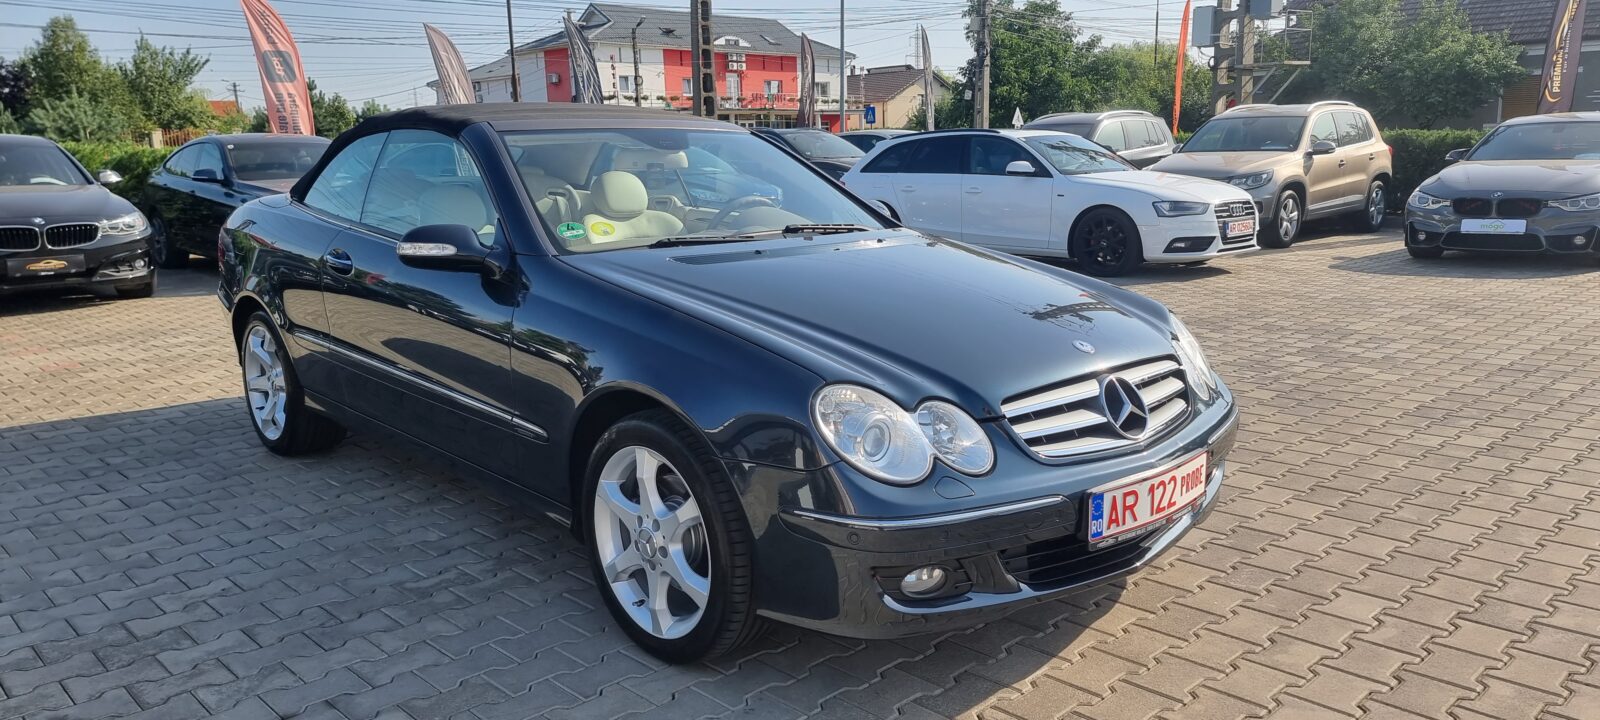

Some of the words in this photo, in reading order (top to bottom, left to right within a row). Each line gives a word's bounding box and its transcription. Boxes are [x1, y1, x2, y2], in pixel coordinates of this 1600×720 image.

[1553, 49, 1563, 92] PREMIUM
[1229, 223, 1237, 233] AR
[1107, 490, 1139, 530] AR
[1147, 475, 1178, 517] 122
[1181, 464, 1204, 496] PROBE
[1091, 518, 1103, 534] RO
